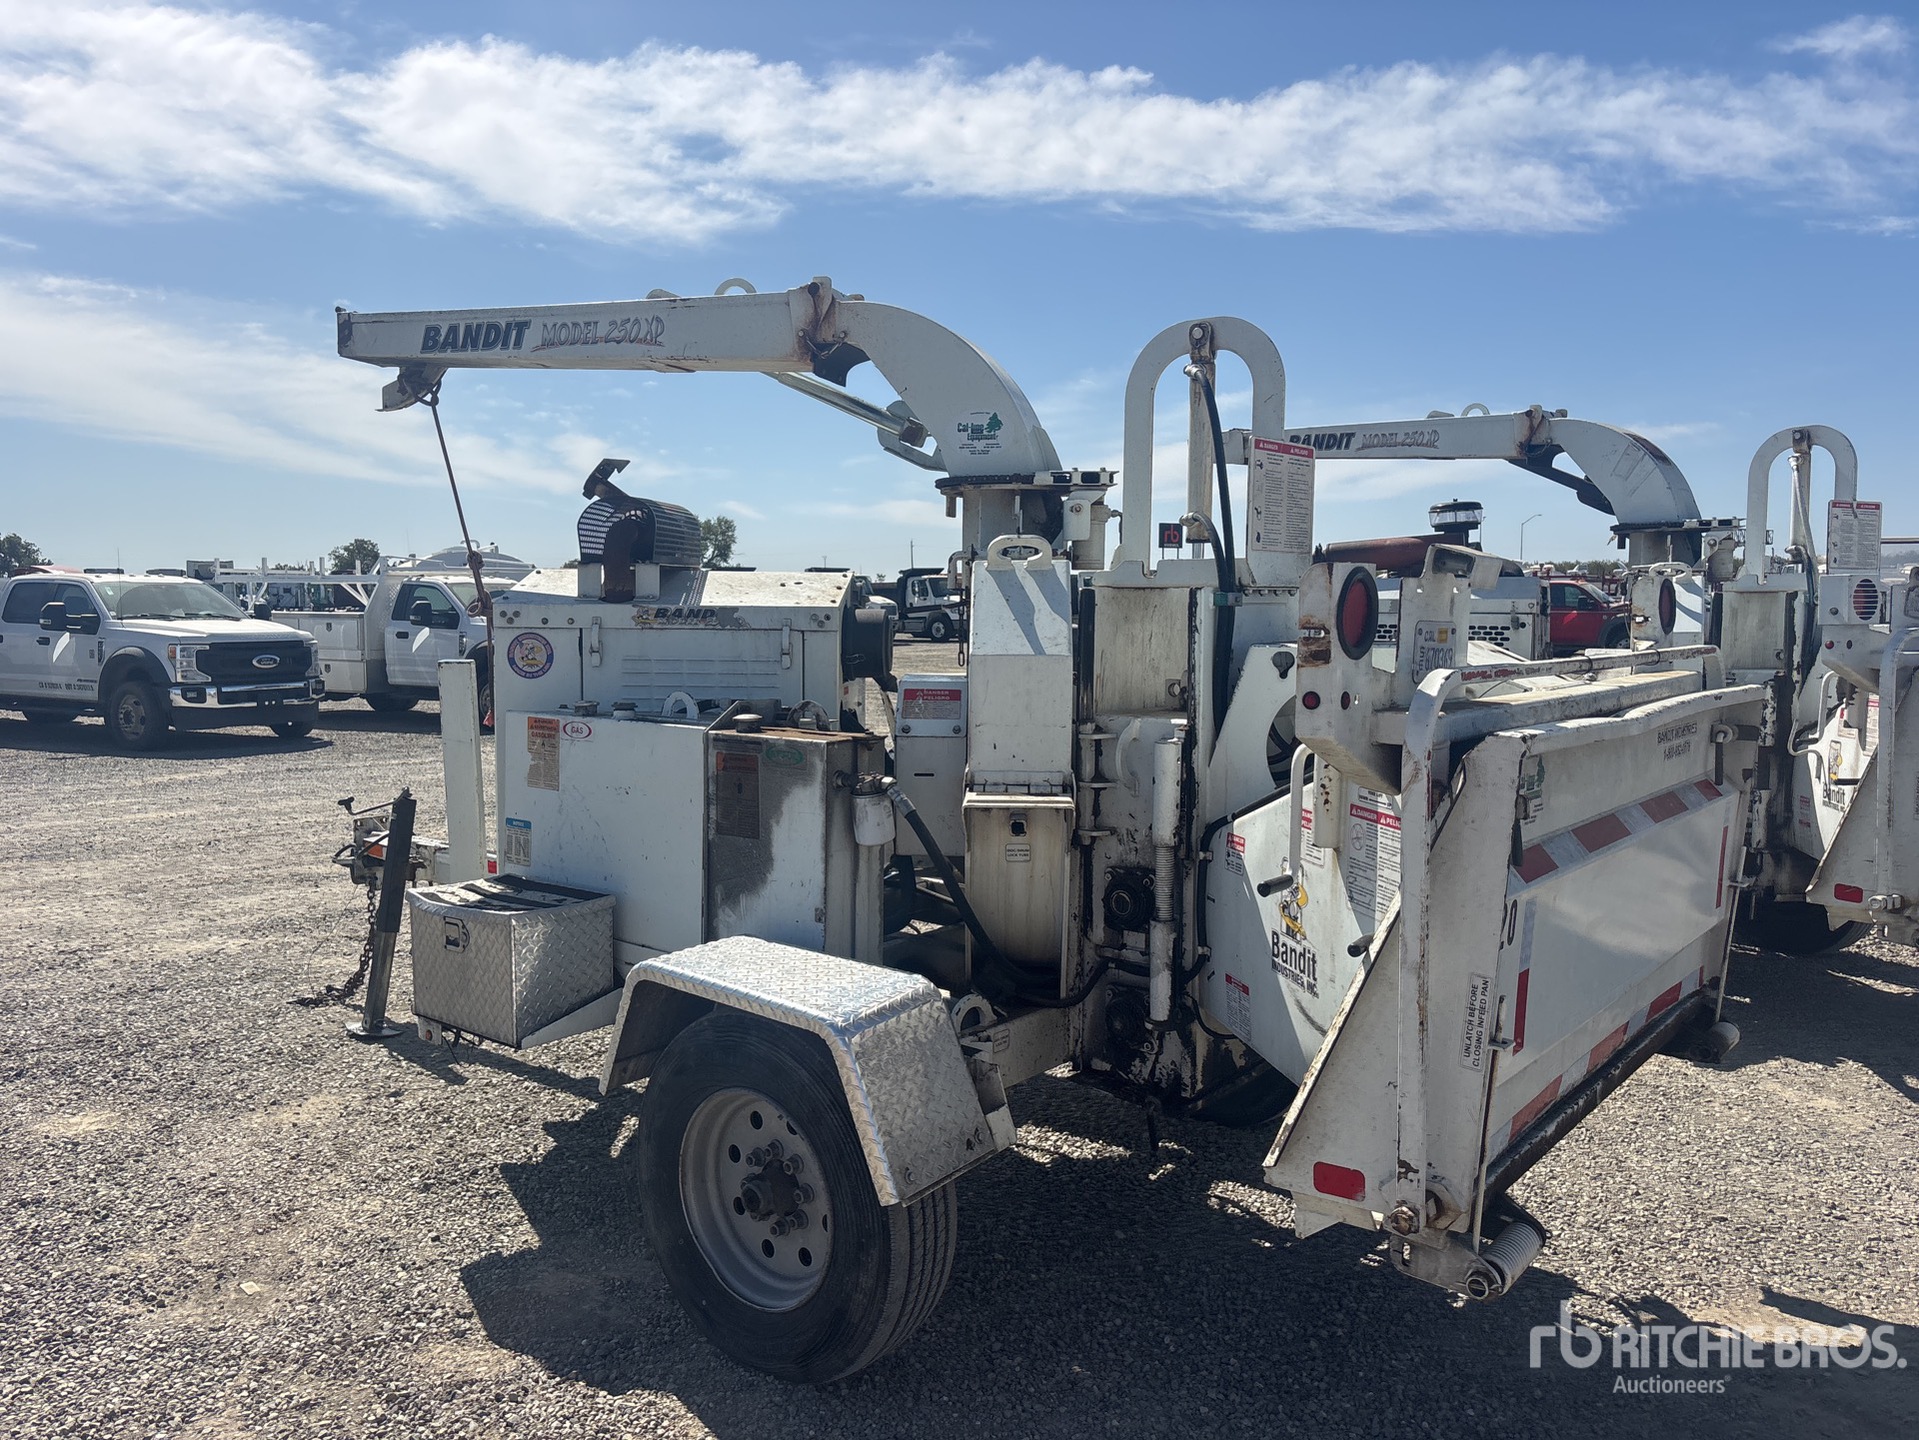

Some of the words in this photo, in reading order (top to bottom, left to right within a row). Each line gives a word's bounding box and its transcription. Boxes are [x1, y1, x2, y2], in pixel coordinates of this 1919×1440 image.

[420, 318, 532, 354] BANDIT
[541, 321, 599, 348] MODEL
[1361, 433, 1400, 449] MODEL
[1164, 524, 1180, 543] rb
[571, 726, 584, 735] GAS
[1357, 808, 1377, 821] DANGER
[1271, 930, 1318, 982] Bandit
[1468, 983, 1479, 1018] BEFORE
[1480, 979, 1490, 997] PAN
[1477, 997, 1487, 1028] INFEED
[1463, 1019, 1475, 1058] UNLATCH
[1472, 1031, 1484, 1068] CLOSING
